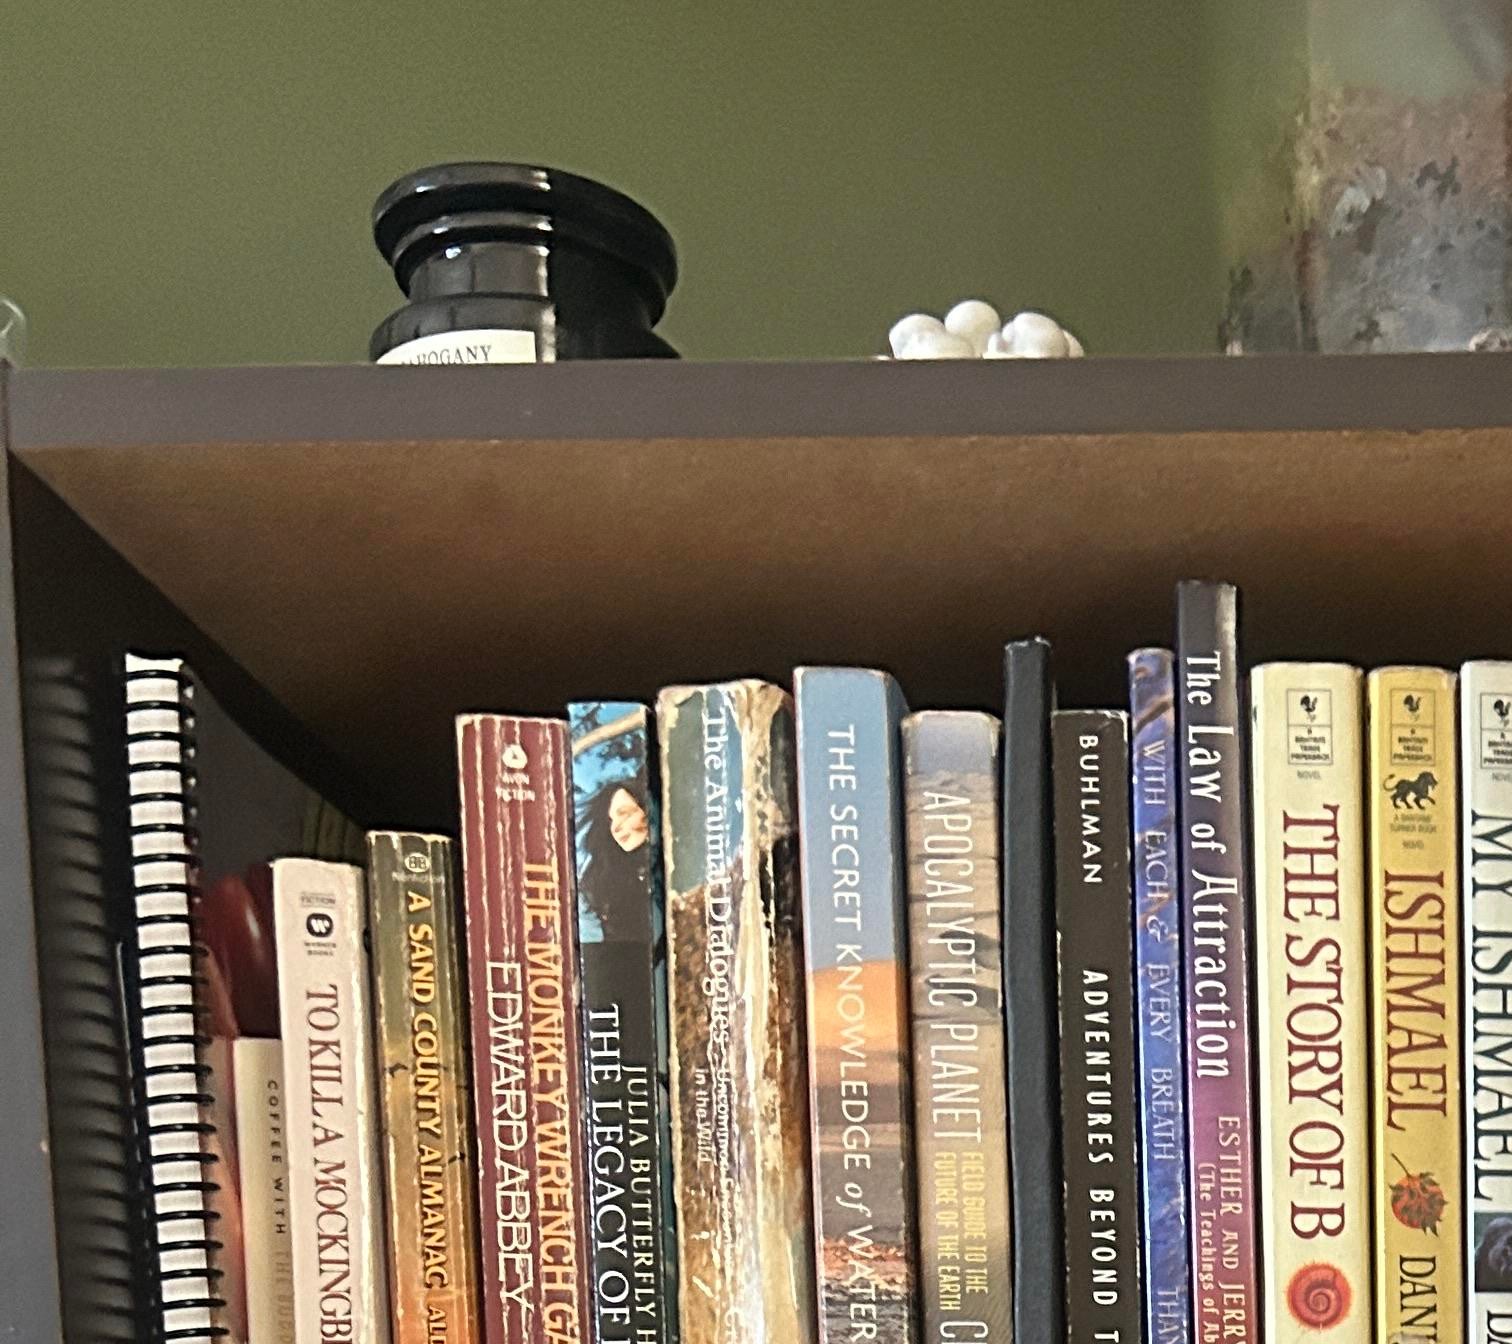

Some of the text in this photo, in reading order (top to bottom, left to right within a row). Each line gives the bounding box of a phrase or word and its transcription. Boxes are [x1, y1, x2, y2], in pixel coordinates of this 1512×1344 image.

[1079, 734, 1103, 884] BUHLMAN
[1186, 650, 1239, 1078] The Law of Attraction
[1282, 804, 1342, 923] THE
[523, 858, 559, 929] THE
[922, 792, 982, 1142] APOCALYPTIC PLANET
[527, 942, 565, 1104] MONKEY
[588, 1004, 620, 1083] THE
[827, 725, 876, 1342] THE SECRET KNOWLEDGE of WATER
[1082, 970, 1114, 1164] ADVENTURES
[1284, 933, 1344, 1116] STORY
[1384, 869, 1447, 1131] ISHMAEL
[486, 961, 534, 1313] EDWARD ABBEY
[535, 1120, 573, 1293] WRENCH
[591, 1099, 629, 1256] LEGACY
[1289, 1120, 1345, 1190] OF
[598, 1270, 630, 1324] OF
[1090, 1189, 1119, 1306] BEYOND
[1291, 1201, 1345, 1240] B
